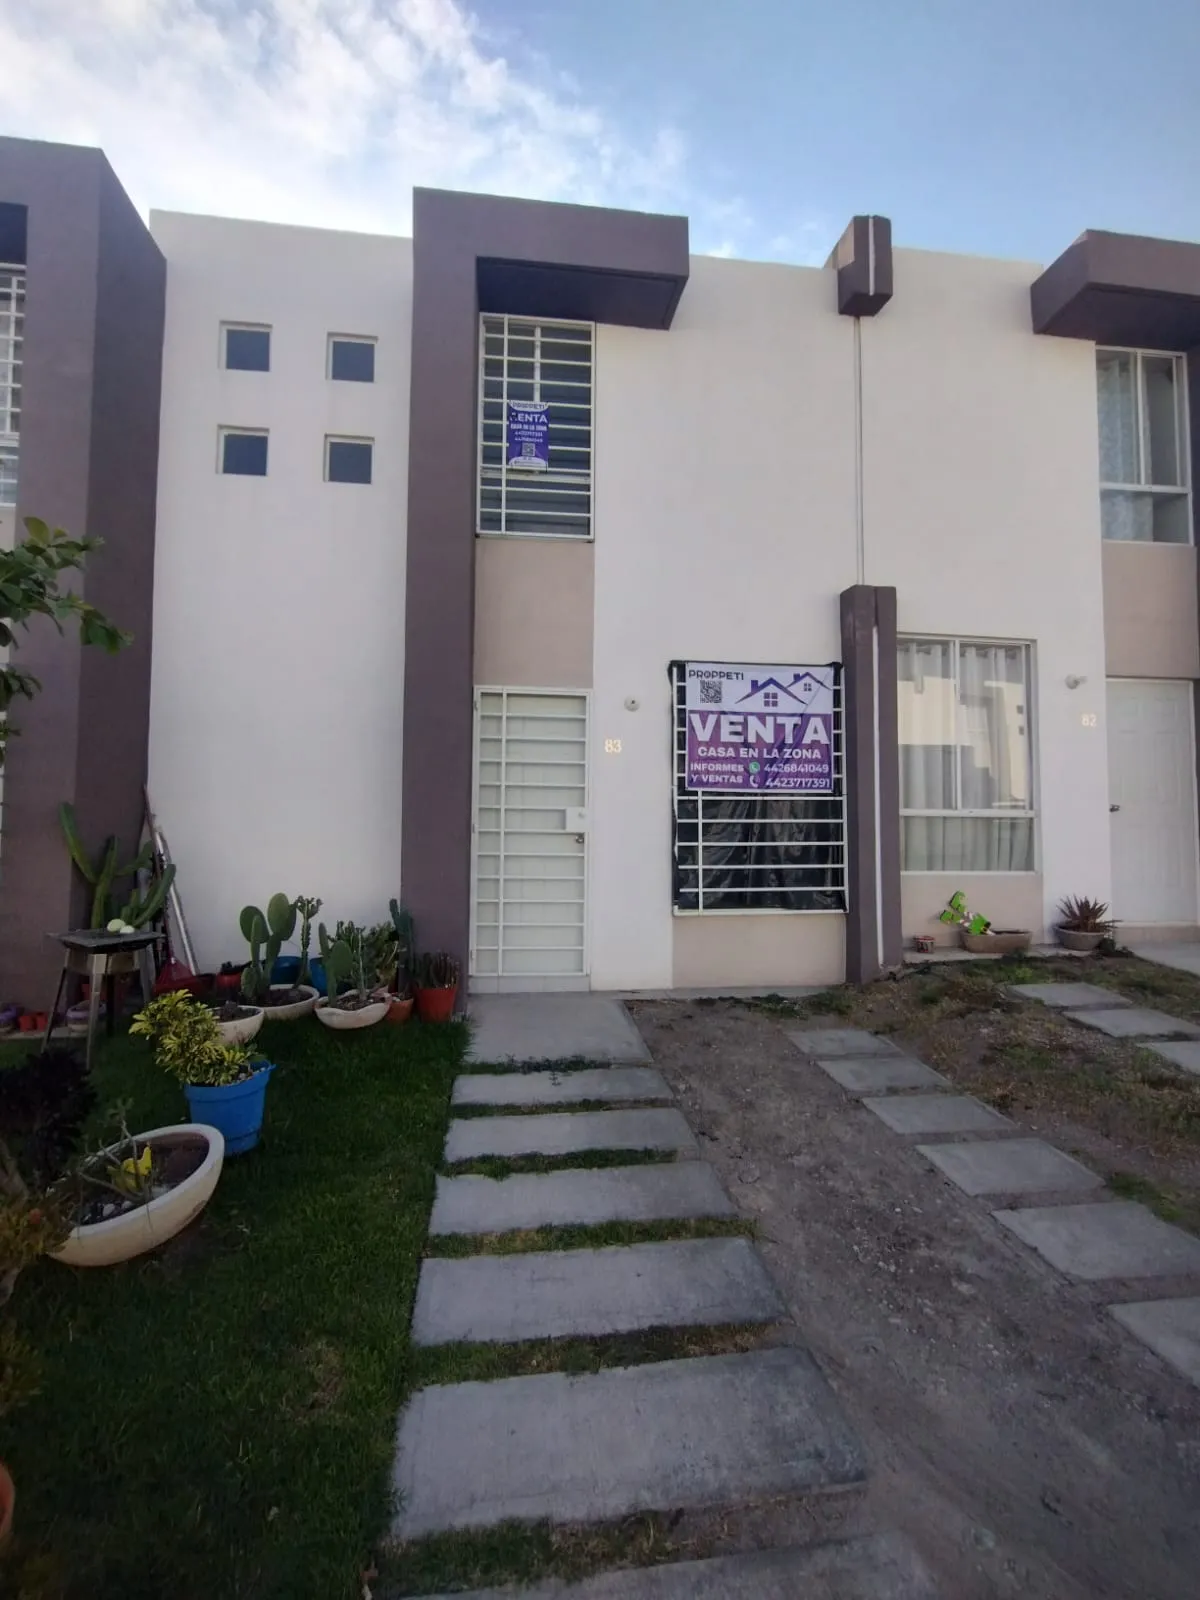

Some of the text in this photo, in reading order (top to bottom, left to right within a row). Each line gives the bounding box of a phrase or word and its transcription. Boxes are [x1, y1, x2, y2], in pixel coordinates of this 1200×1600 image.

[688, 669, 744, 681] PROPPETI
[689, 713, 830, 745] VENTA
[698, 746, 821, 759] CASA EN LA ZONA
[690, 762, 744, 772] INFORMES
[764, 763, 829, 773] 4426841049
[691, 774, 743, 783] Y VENTAS
[765, 777, 830, 788] 4423717391
